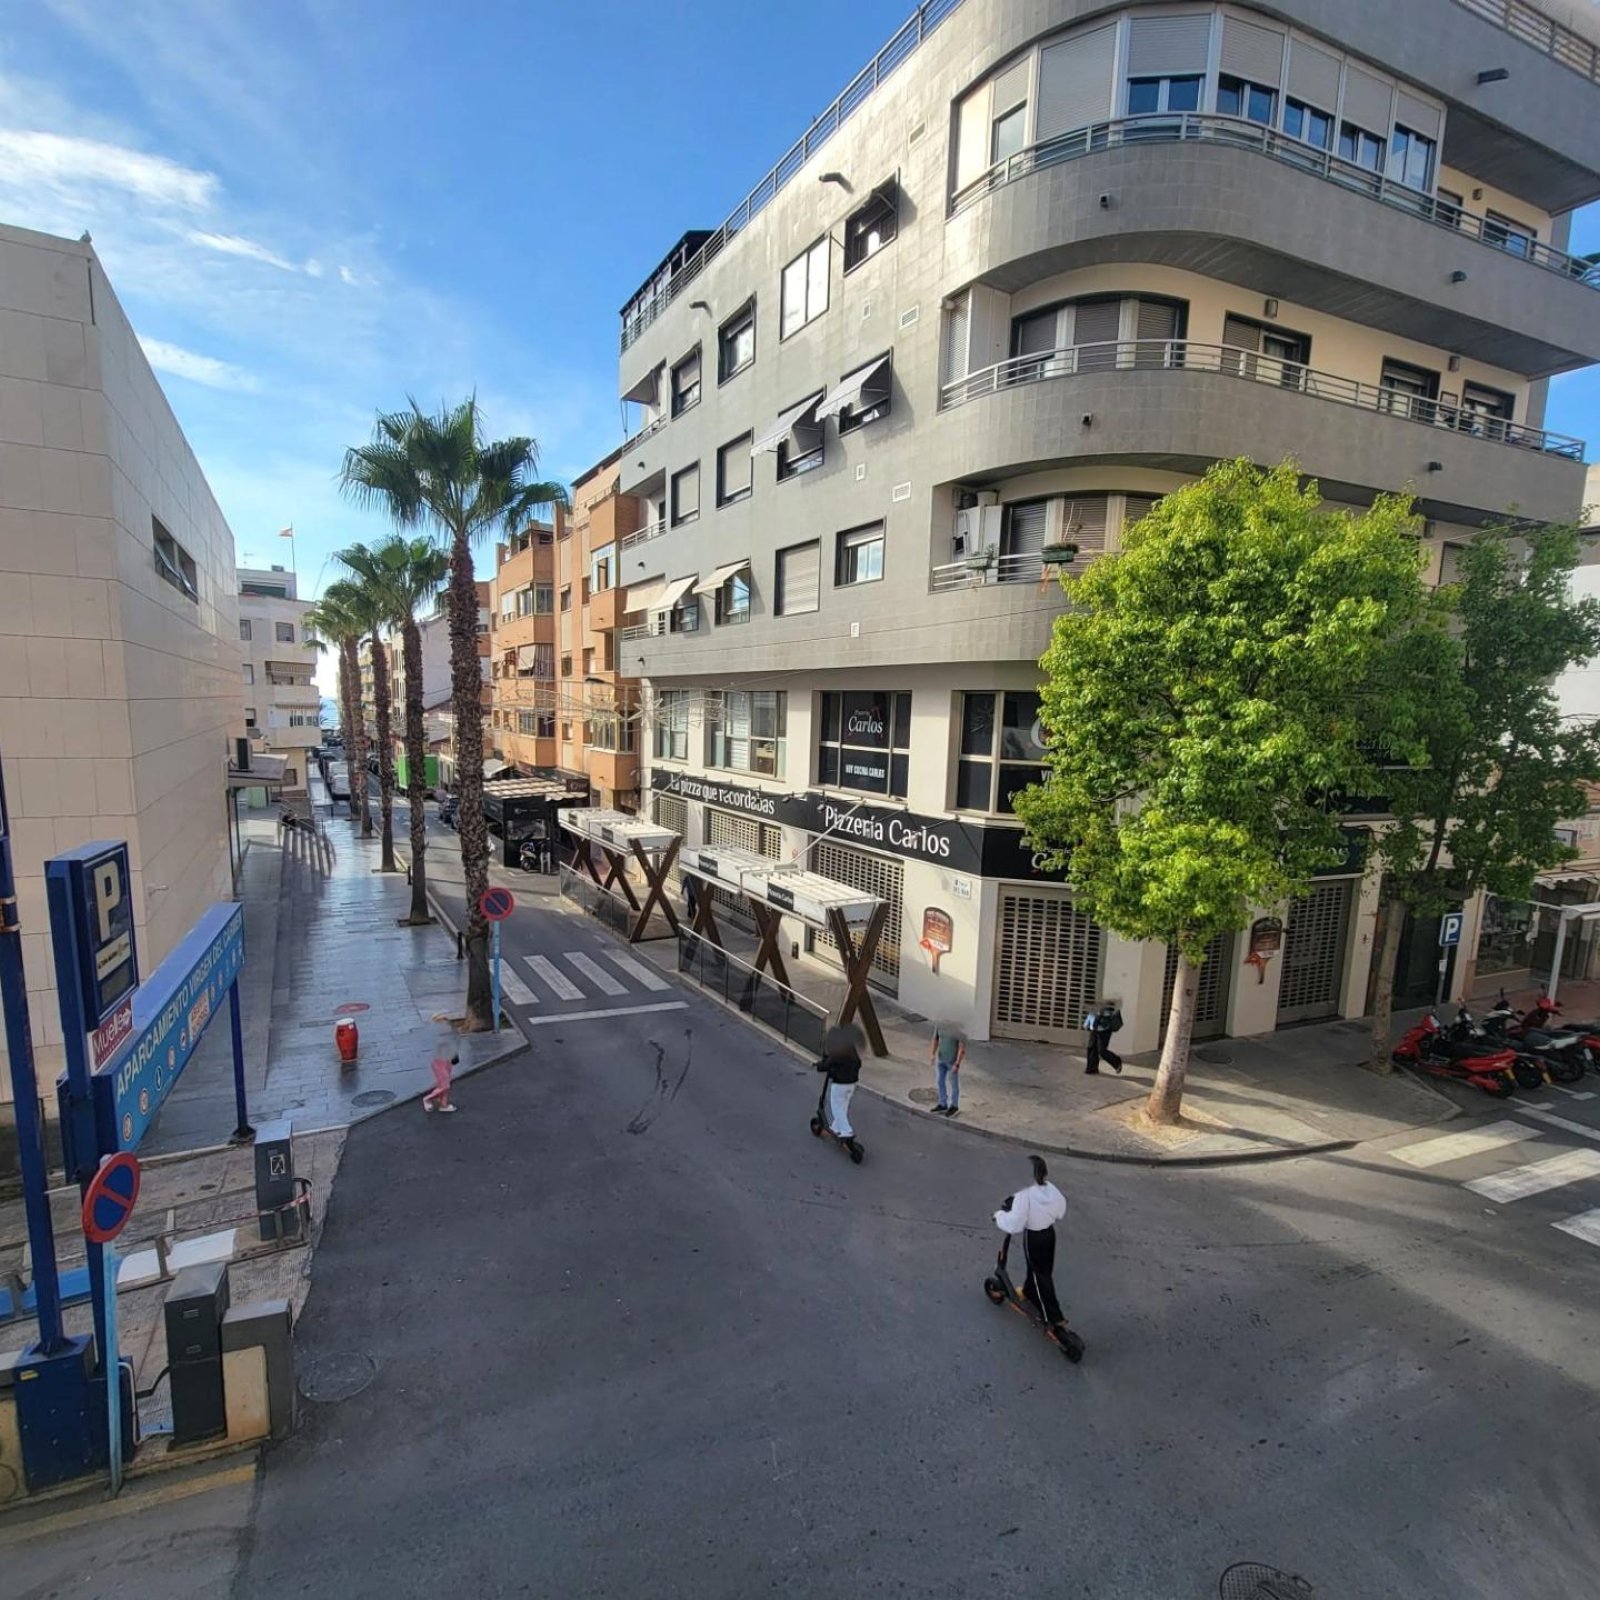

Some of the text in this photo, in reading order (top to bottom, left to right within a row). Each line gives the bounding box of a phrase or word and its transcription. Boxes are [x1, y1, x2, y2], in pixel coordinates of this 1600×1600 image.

[848, 715, 883, 734] Carlos
[681, 778, 702, 796] pizza
[702, 783, 717, 802] que
[719, 788, 775, 815] recordabas
[825, 805, 950, 857] Pizzería Carlos
[93, 860, 121, 943] P
[1445, 918, 1459, 942] P
[117, 985, 189, 1103] APARCAMIENTO
